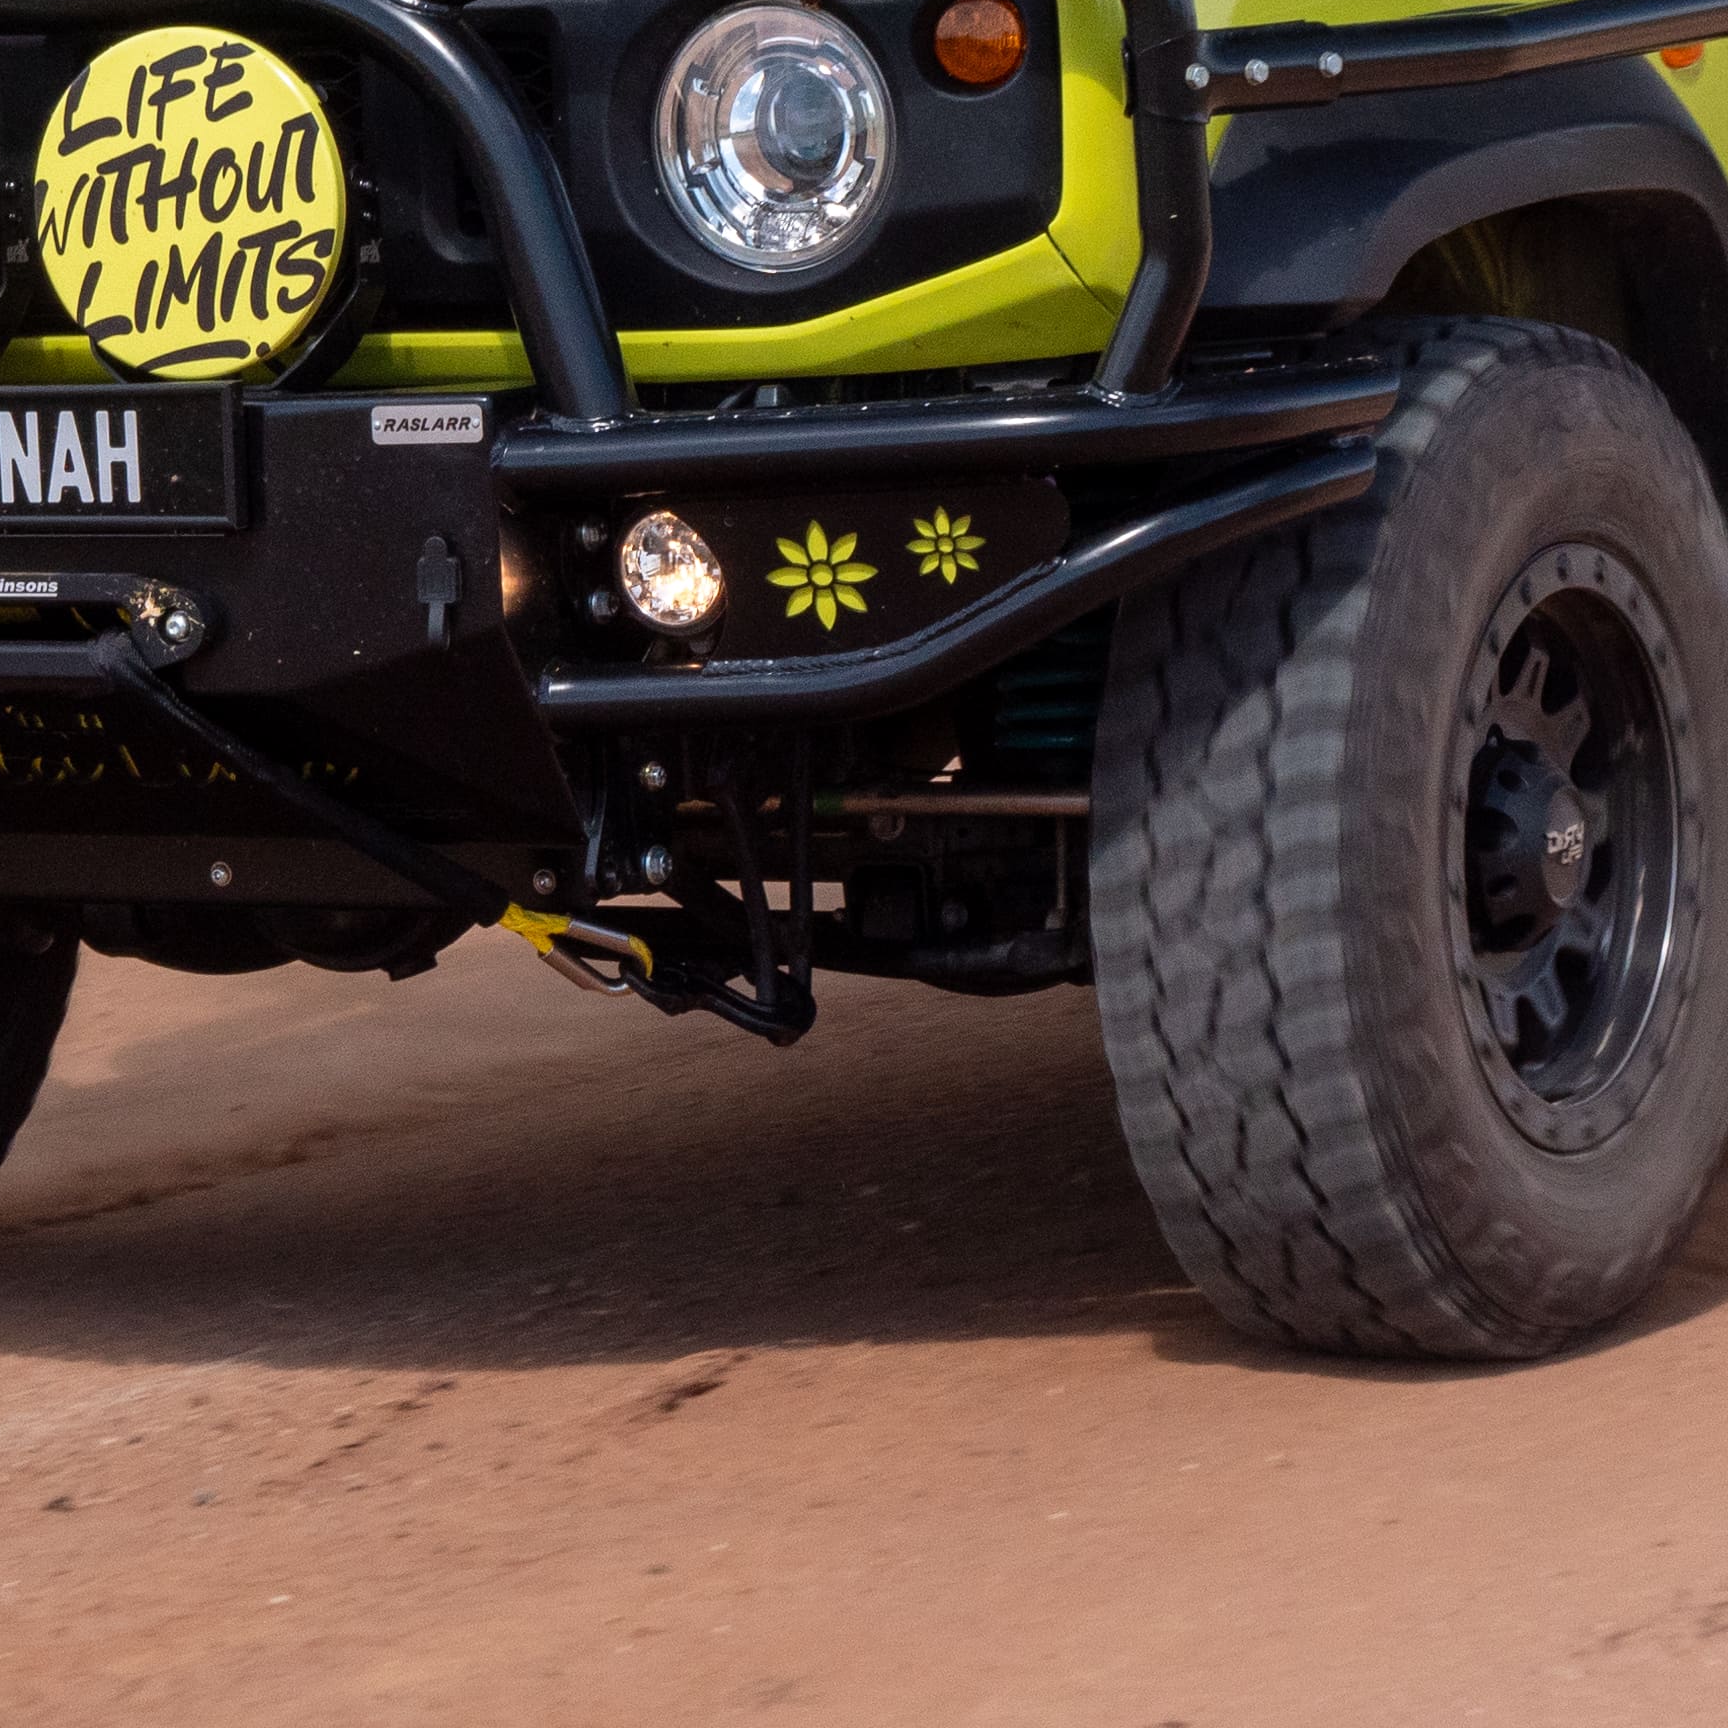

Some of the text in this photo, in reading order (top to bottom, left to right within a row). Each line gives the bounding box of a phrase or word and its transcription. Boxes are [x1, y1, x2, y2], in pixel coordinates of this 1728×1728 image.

[58, 41, 255, 156] LIFE
[36, 112, 320, 256] WITHOUT
[384, 416, 472, 432] RASLARR
